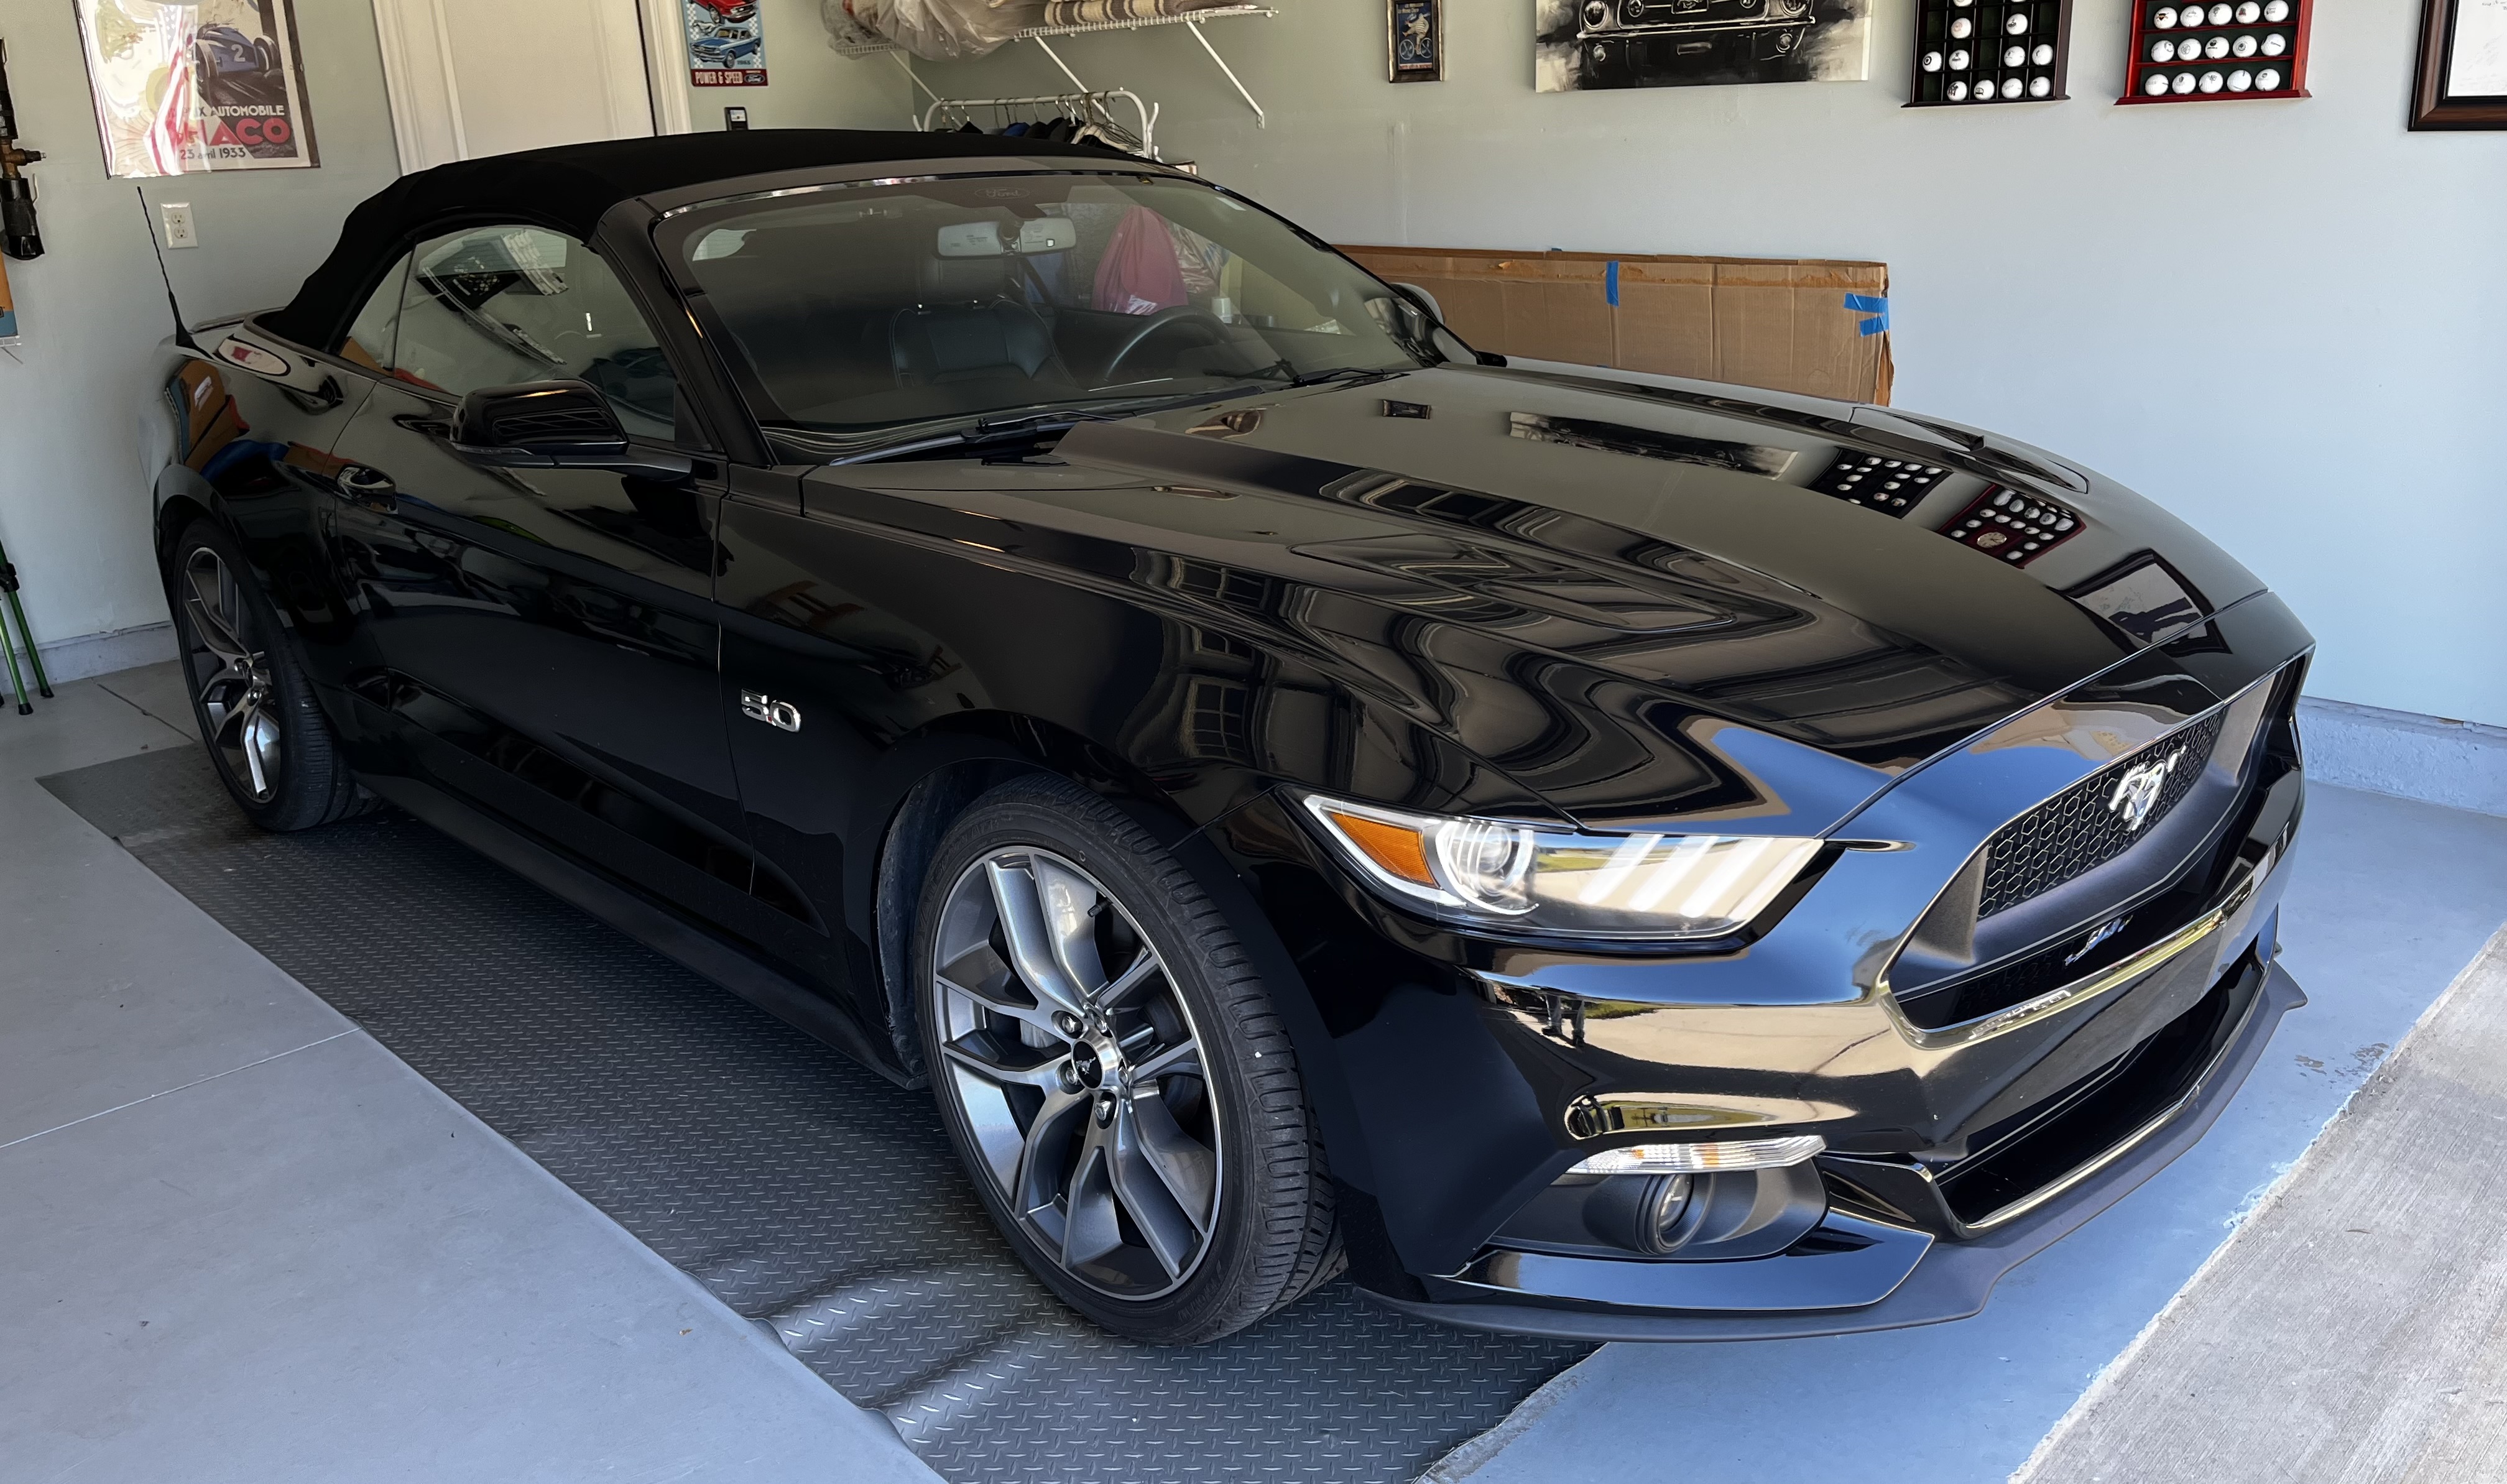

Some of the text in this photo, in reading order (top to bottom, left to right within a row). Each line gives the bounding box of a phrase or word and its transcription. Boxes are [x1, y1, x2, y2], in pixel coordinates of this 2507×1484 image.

[231, 44, 246, 62] 2
[695, 71, 717, 84] POWER
[724, 71, 743, 84] SPEED
[210, 105, 285, 116] AUTOMOBILE
[180, 147, 246, 160] 23 aril 1933
[986, 188, 1022, 197] Ford
[741, 688, 801, 733] 5.0
